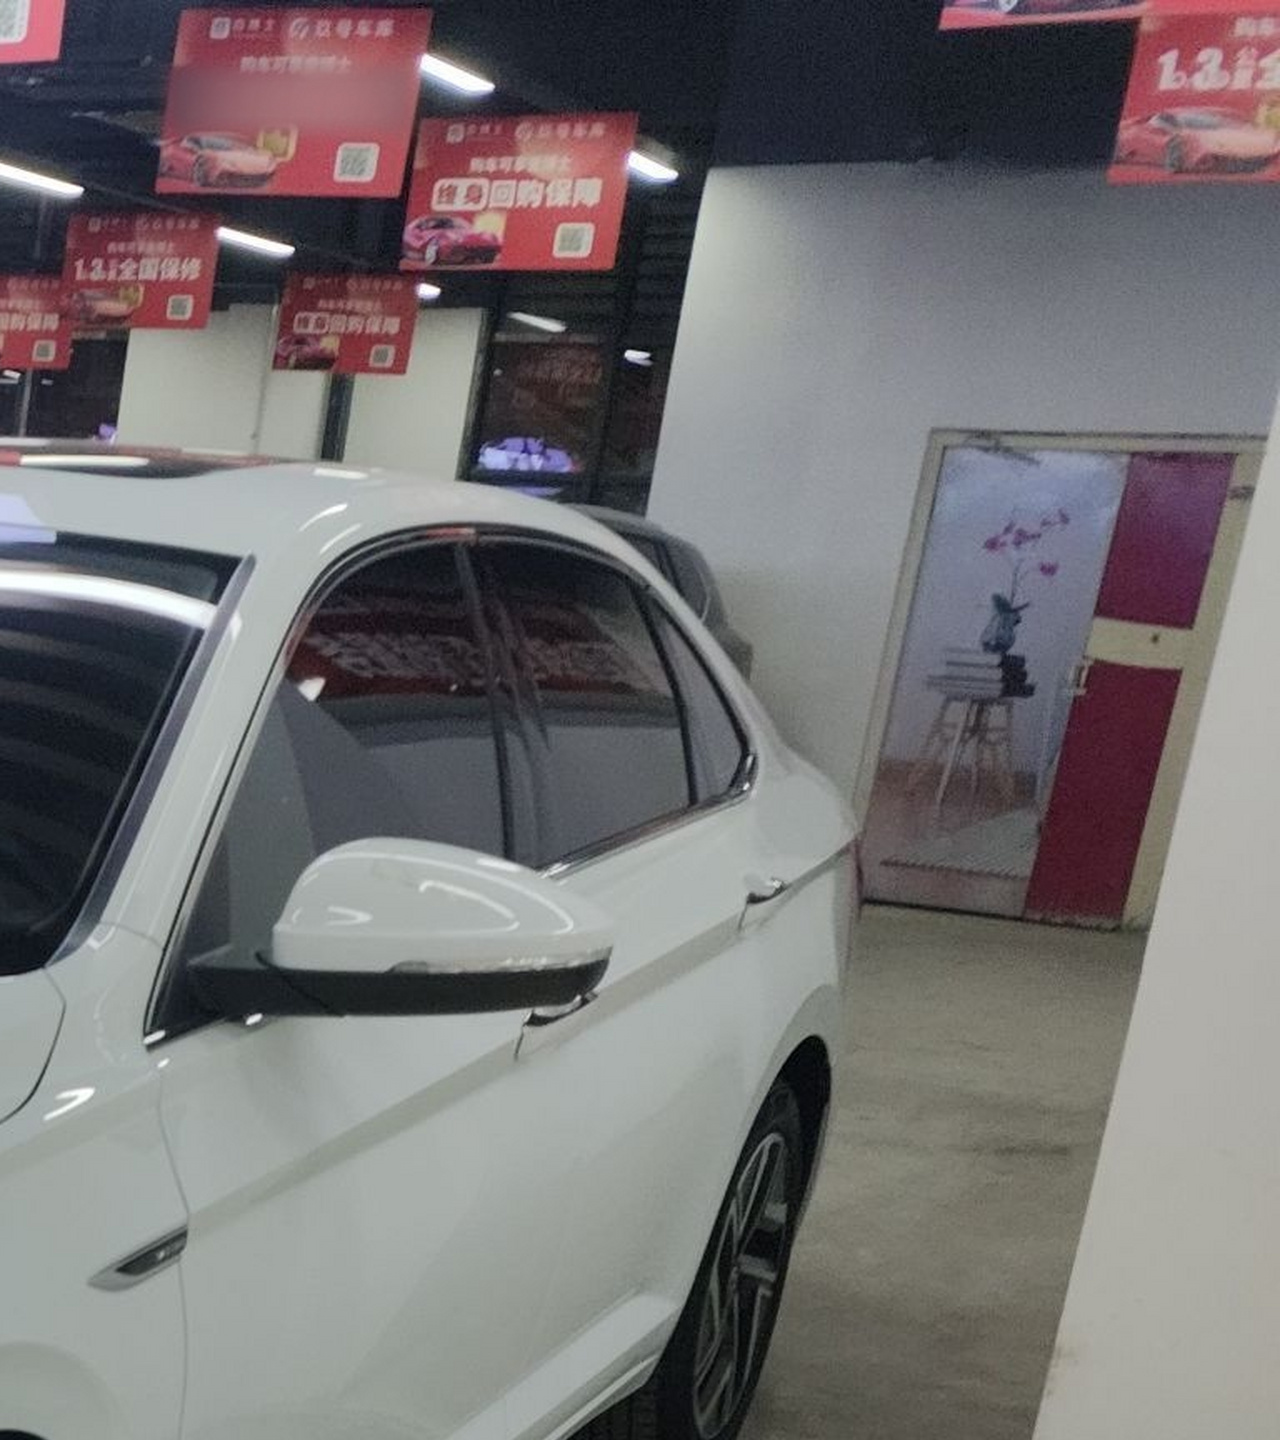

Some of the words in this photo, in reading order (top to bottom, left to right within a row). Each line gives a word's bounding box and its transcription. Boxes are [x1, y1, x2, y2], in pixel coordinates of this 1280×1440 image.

[433, 177, 603, 210] 终身回购保障
